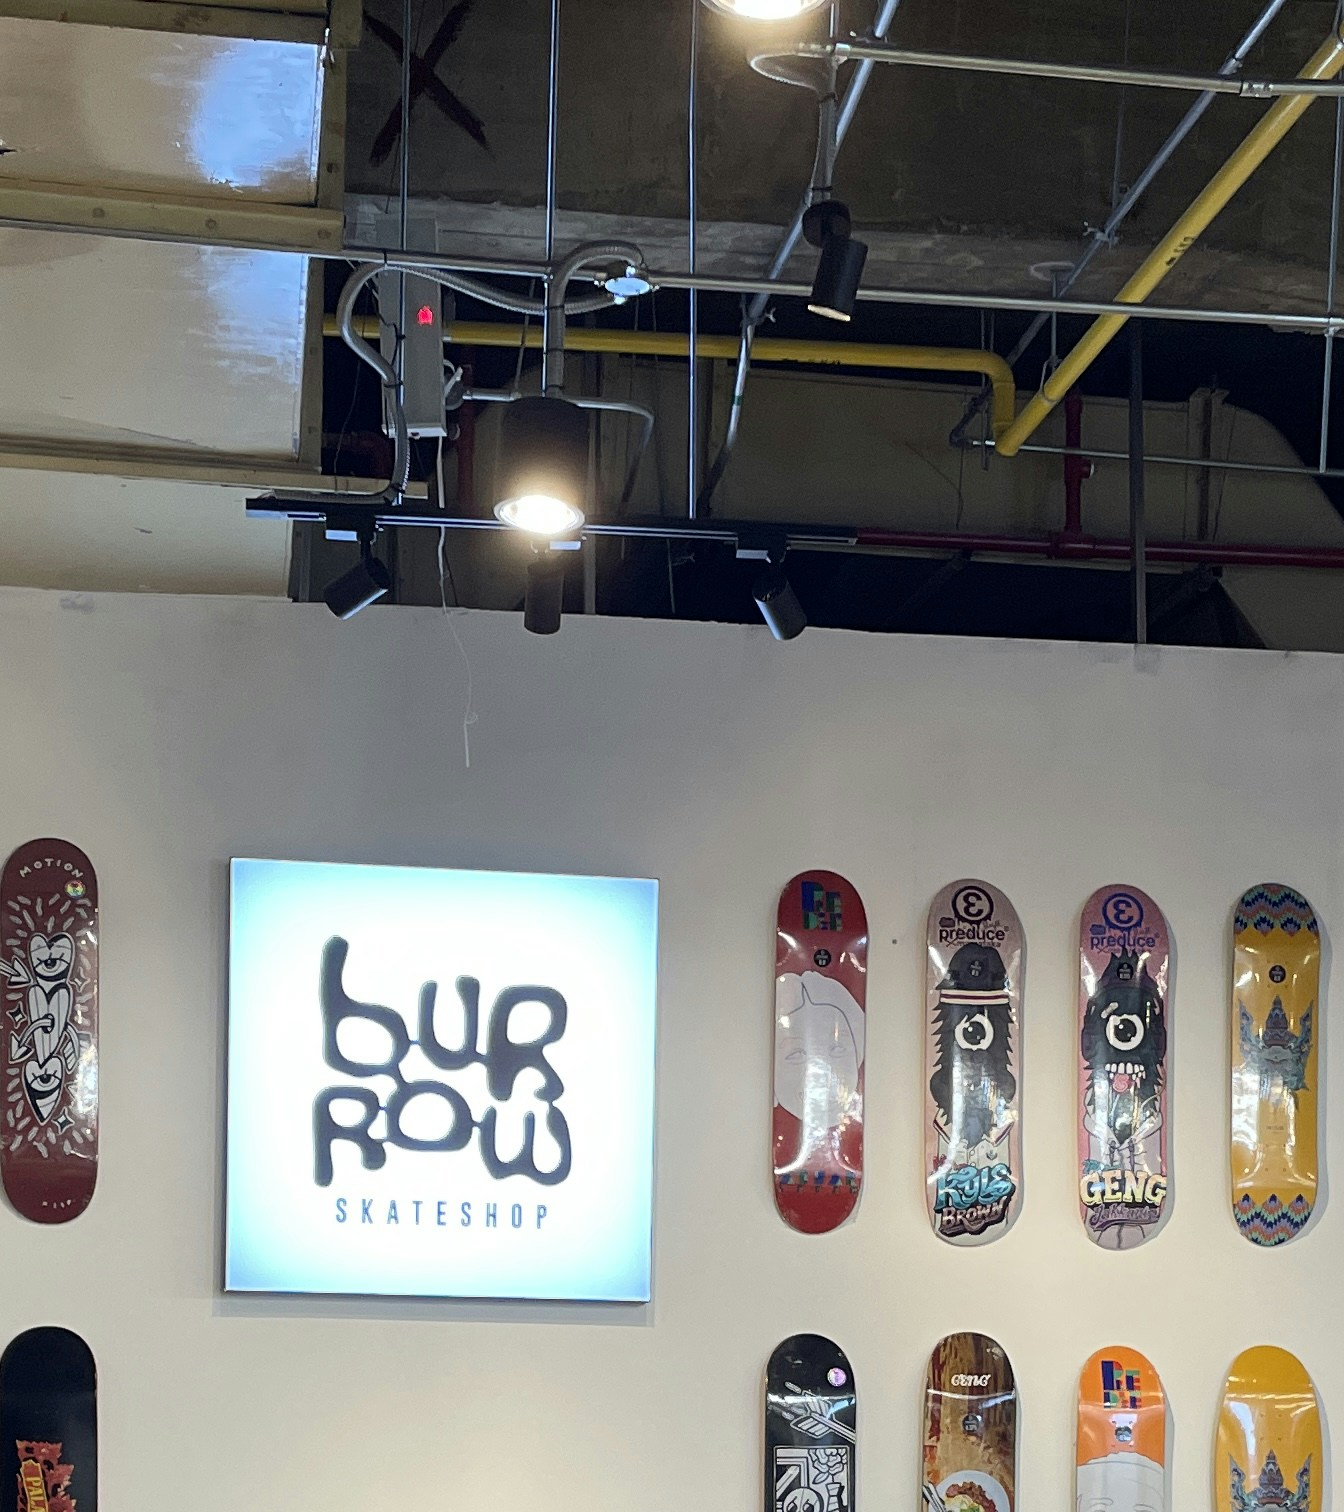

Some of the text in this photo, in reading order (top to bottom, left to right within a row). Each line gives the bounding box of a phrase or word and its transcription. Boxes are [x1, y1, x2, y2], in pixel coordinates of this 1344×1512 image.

[19, 858, 83, 878] MOTION
[939, 926, 1005, 943] preduce
[1090, 932, 1156, 950] preduce
[1080, 1169, 1168, 1206] GENG
[335, 1197, 550, 1230] SKATESHOP
[942, 1196, 1008, 1228] BROWN
